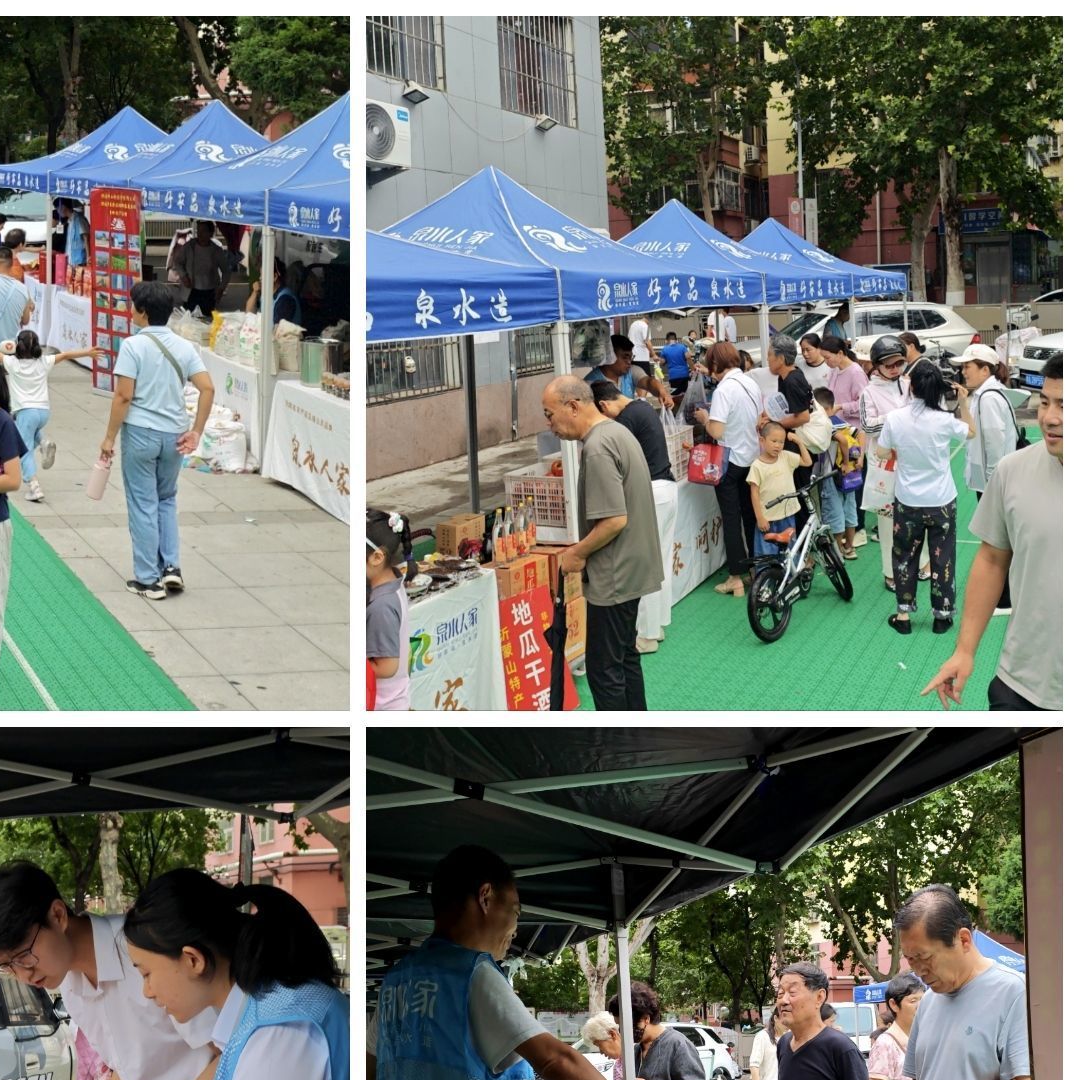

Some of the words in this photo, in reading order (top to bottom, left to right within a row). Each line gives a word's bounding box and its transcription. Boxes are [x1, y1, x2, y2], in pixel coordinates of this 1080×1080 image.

[415, 287, 513, 330] 泉水造
[646, 276, 698, 305] 好农品
[710, 277, 747, 300] 泉水造
[436, 606, 478, 646] 泉水人家
[510, 599, 552, 711] 地瓜干酒
